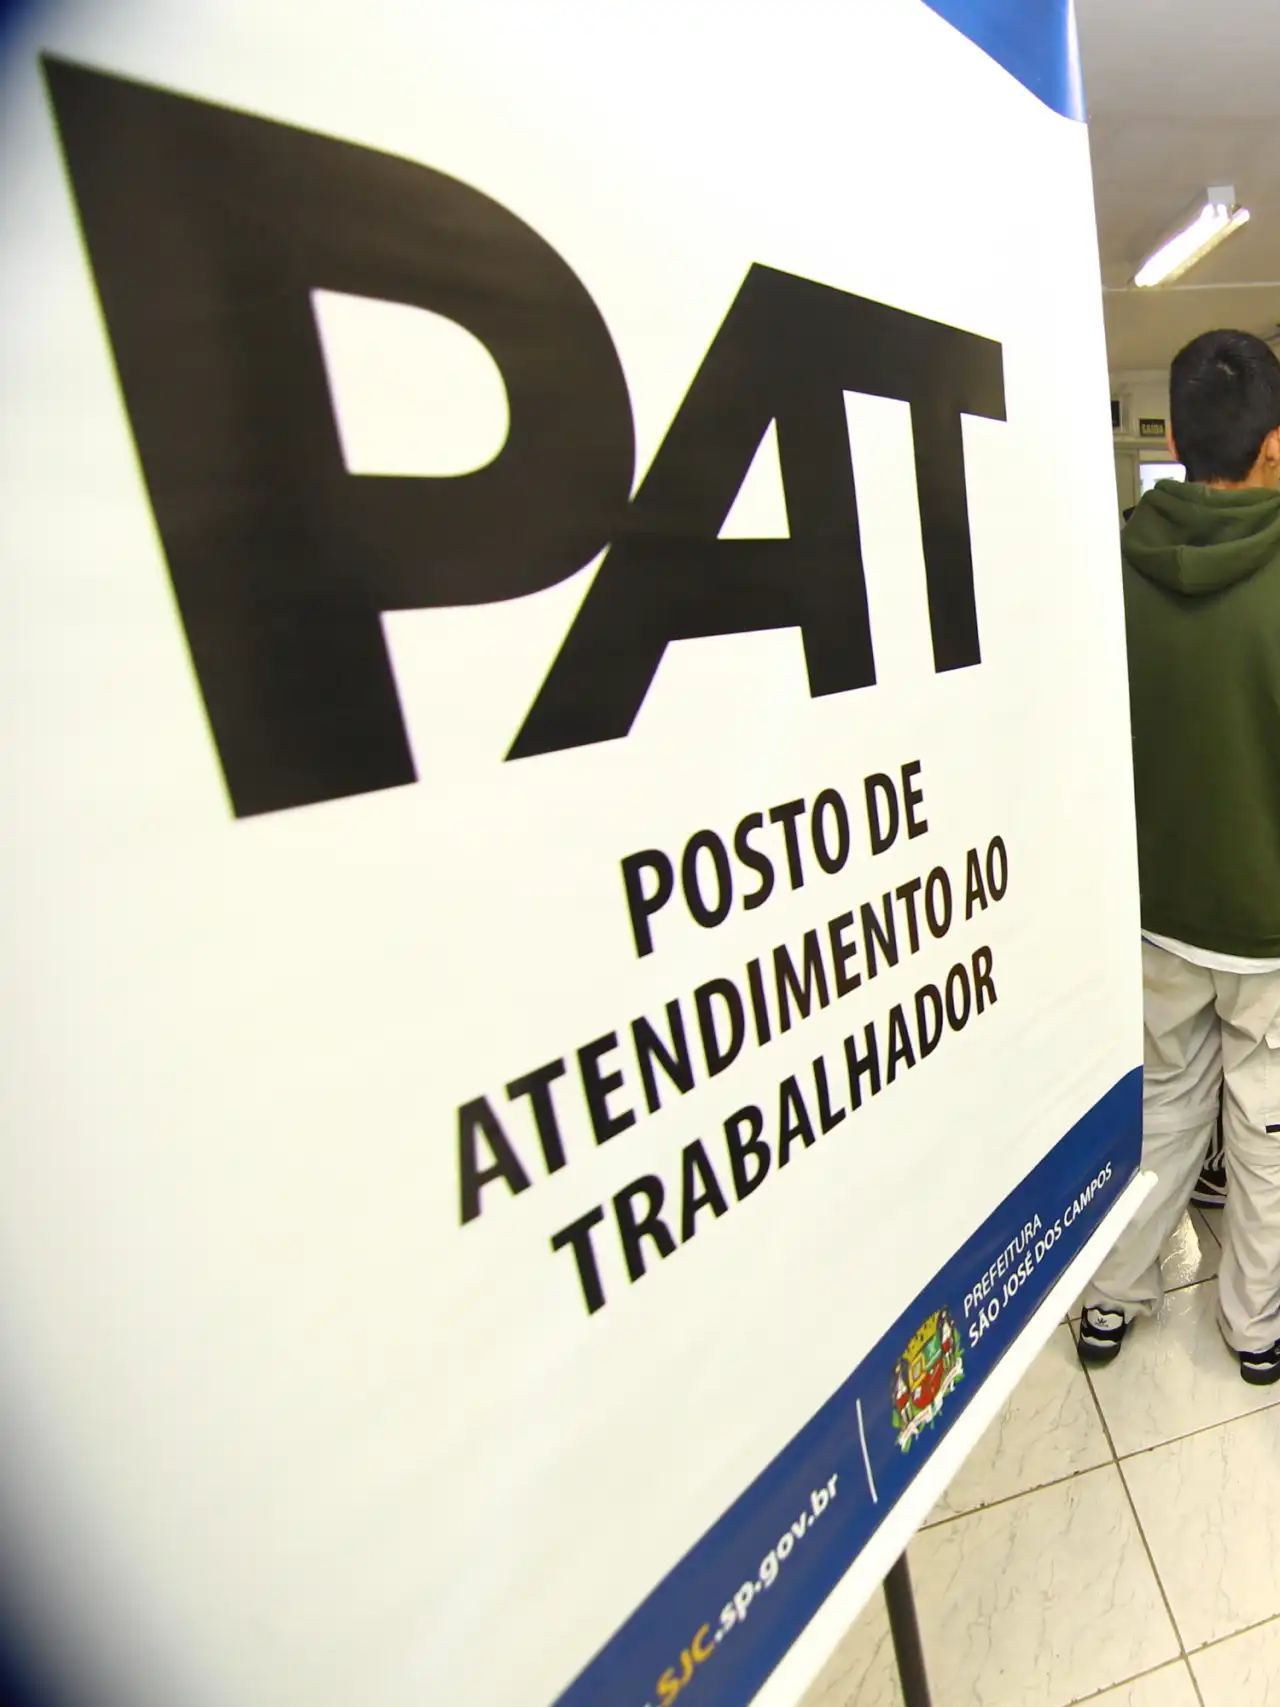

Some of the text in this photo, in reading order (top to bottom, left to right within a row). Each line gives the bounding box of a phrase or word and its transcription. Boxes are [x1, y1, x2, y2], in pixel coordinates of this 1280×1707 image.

[38, 49, 1007, 819] PAT
[621, 759, 929, 958] POSTO DE
[457, 835, 1008, 1226] ATENDIMENTO AO
[550, 945, 998, 1316] TRABALHADOR
[963, 1213, 1042, 1319] PREFEITURA
[968, 1161, 1113, 1348] SÃO JOSÉ DOS CAMPOS
[643, 1472, 838, 1707] SJC.sp.gov.br
